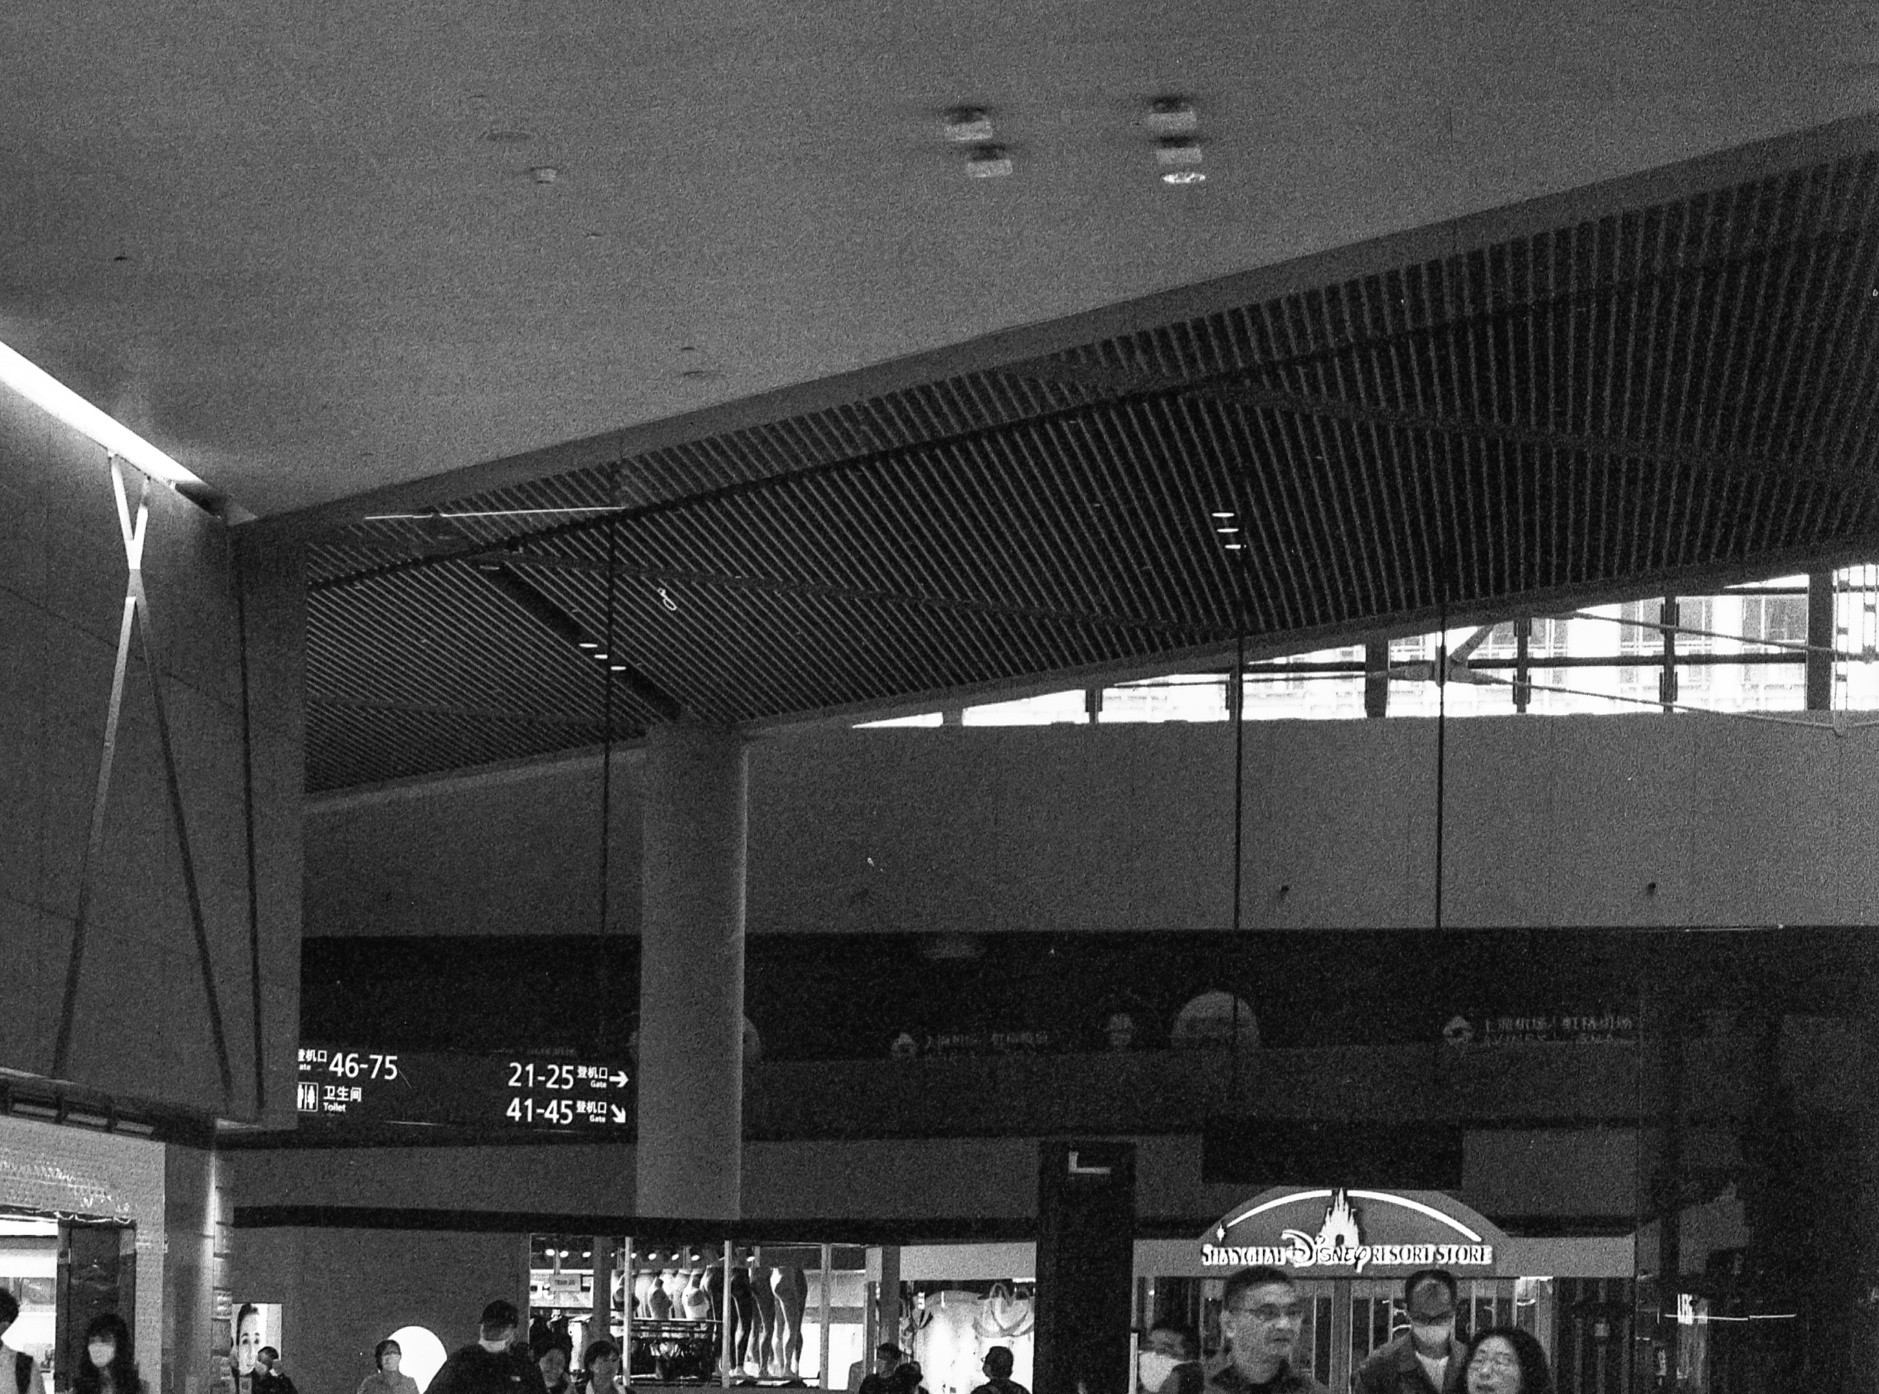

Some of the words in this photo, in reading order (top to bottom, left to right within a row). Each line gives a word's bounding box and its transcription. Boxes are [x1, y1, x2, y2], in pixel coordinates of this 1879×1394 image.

[328, 1052, 398, 1080] 46-75
[507, 1062, 574, 1090] 21-25
[577, 1065, 608, 1079] 登机口
[590, 1080, 608, 1088] Gate
[323, 1085, 362, 1102] 卫生间
[323, 1102, 347, 1113] Toilet
[506, 1097, 573, 1125] 41-45
[576, 1100, 607, 1114] 登机口
[589, 1114, 606, 1123] Gate
[1371, 1244, 1436, 1265] RESORT
[1435, 1244, 1493, 1265] STORE
